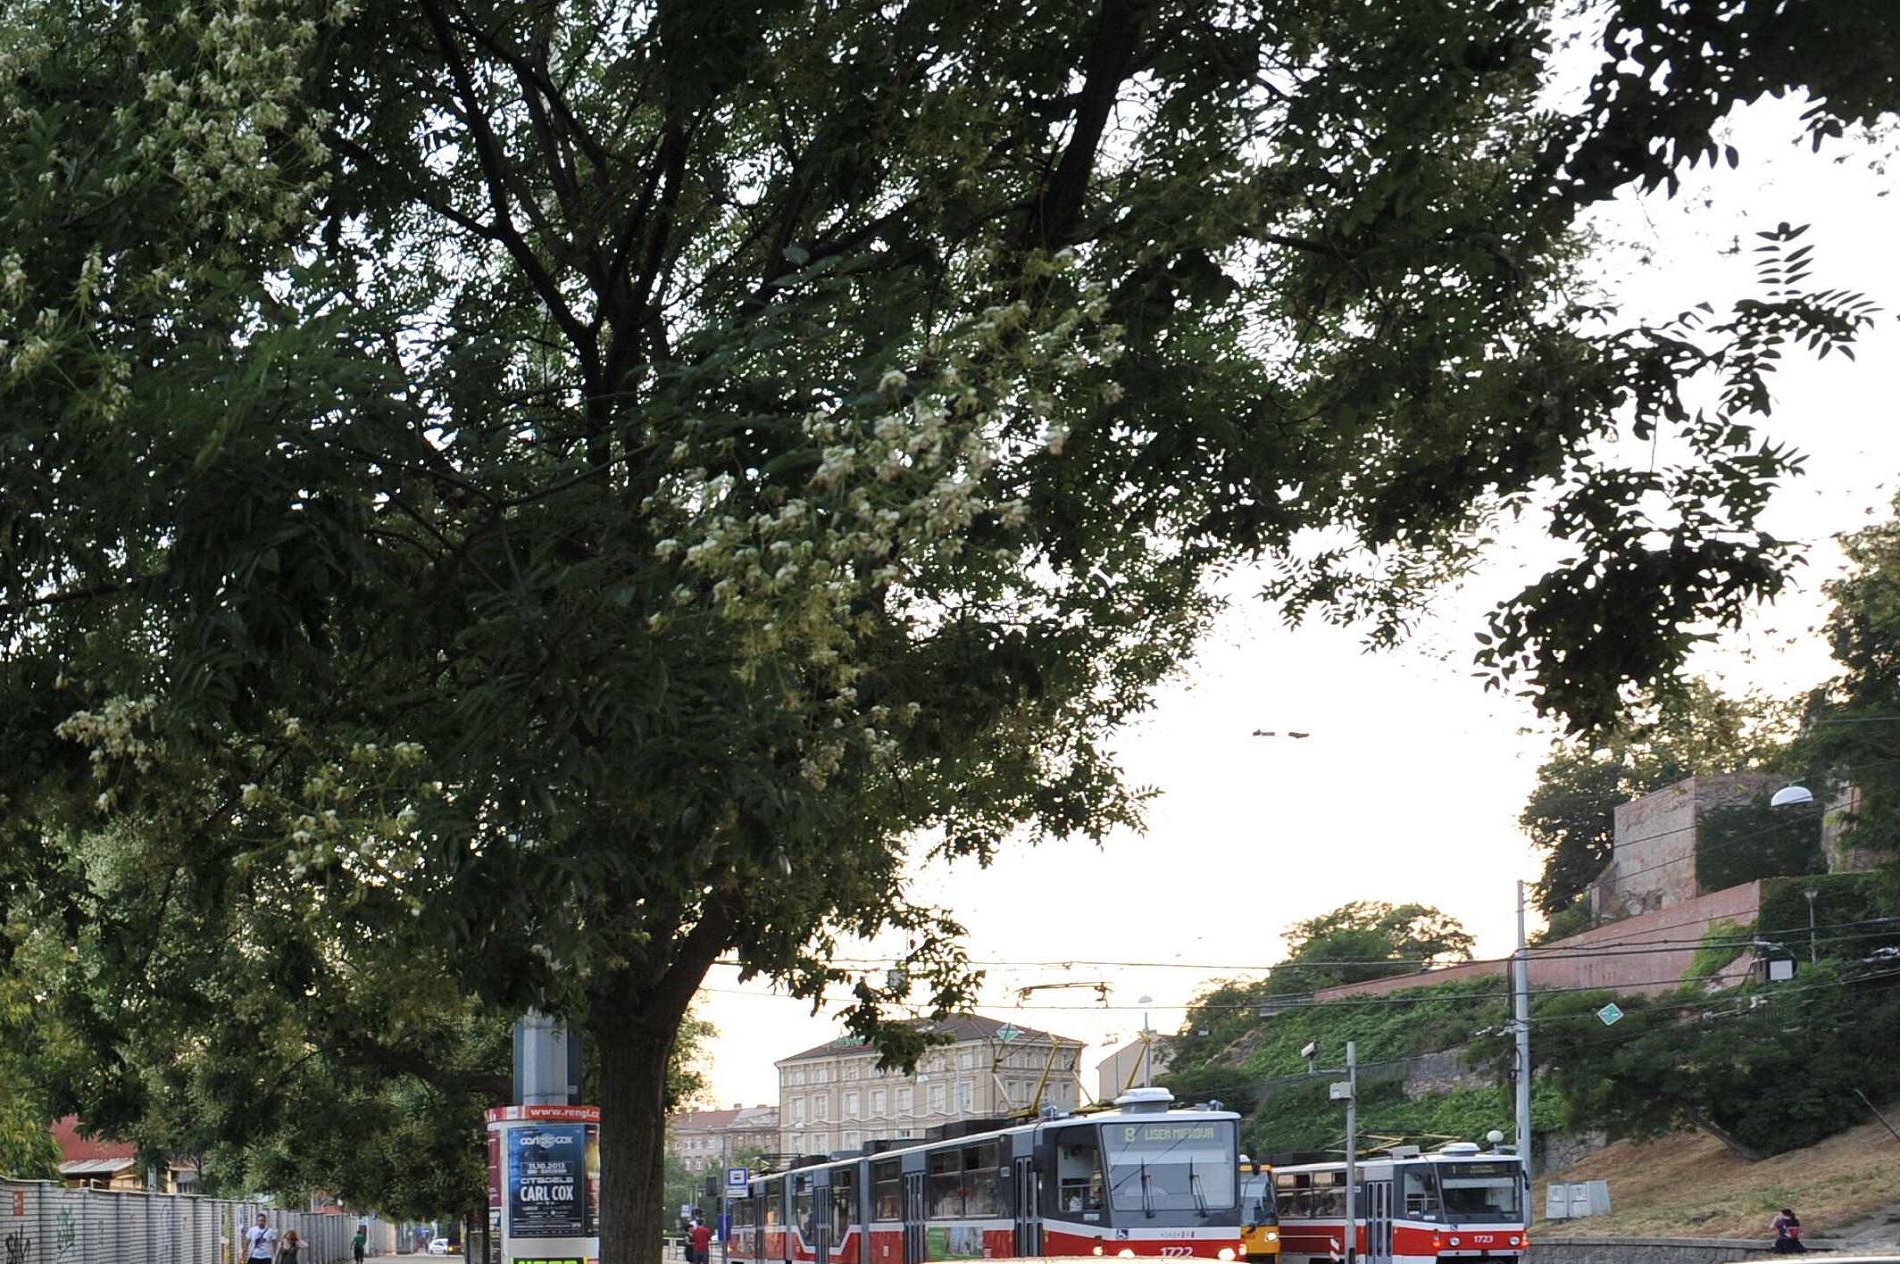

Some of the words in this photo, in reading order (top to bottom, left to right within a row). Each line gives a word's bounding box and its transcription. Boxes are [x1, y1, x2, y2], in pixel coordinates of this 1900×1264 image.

[1124, 1127, 1136, 1142] 8
[520, 1186, 550, 1201] CARL
[552, 1185, 574, 1201] COX
[1474, 1235, 1494, 1244] 1723
[1160, 1246, 1194, 1257] 1722
